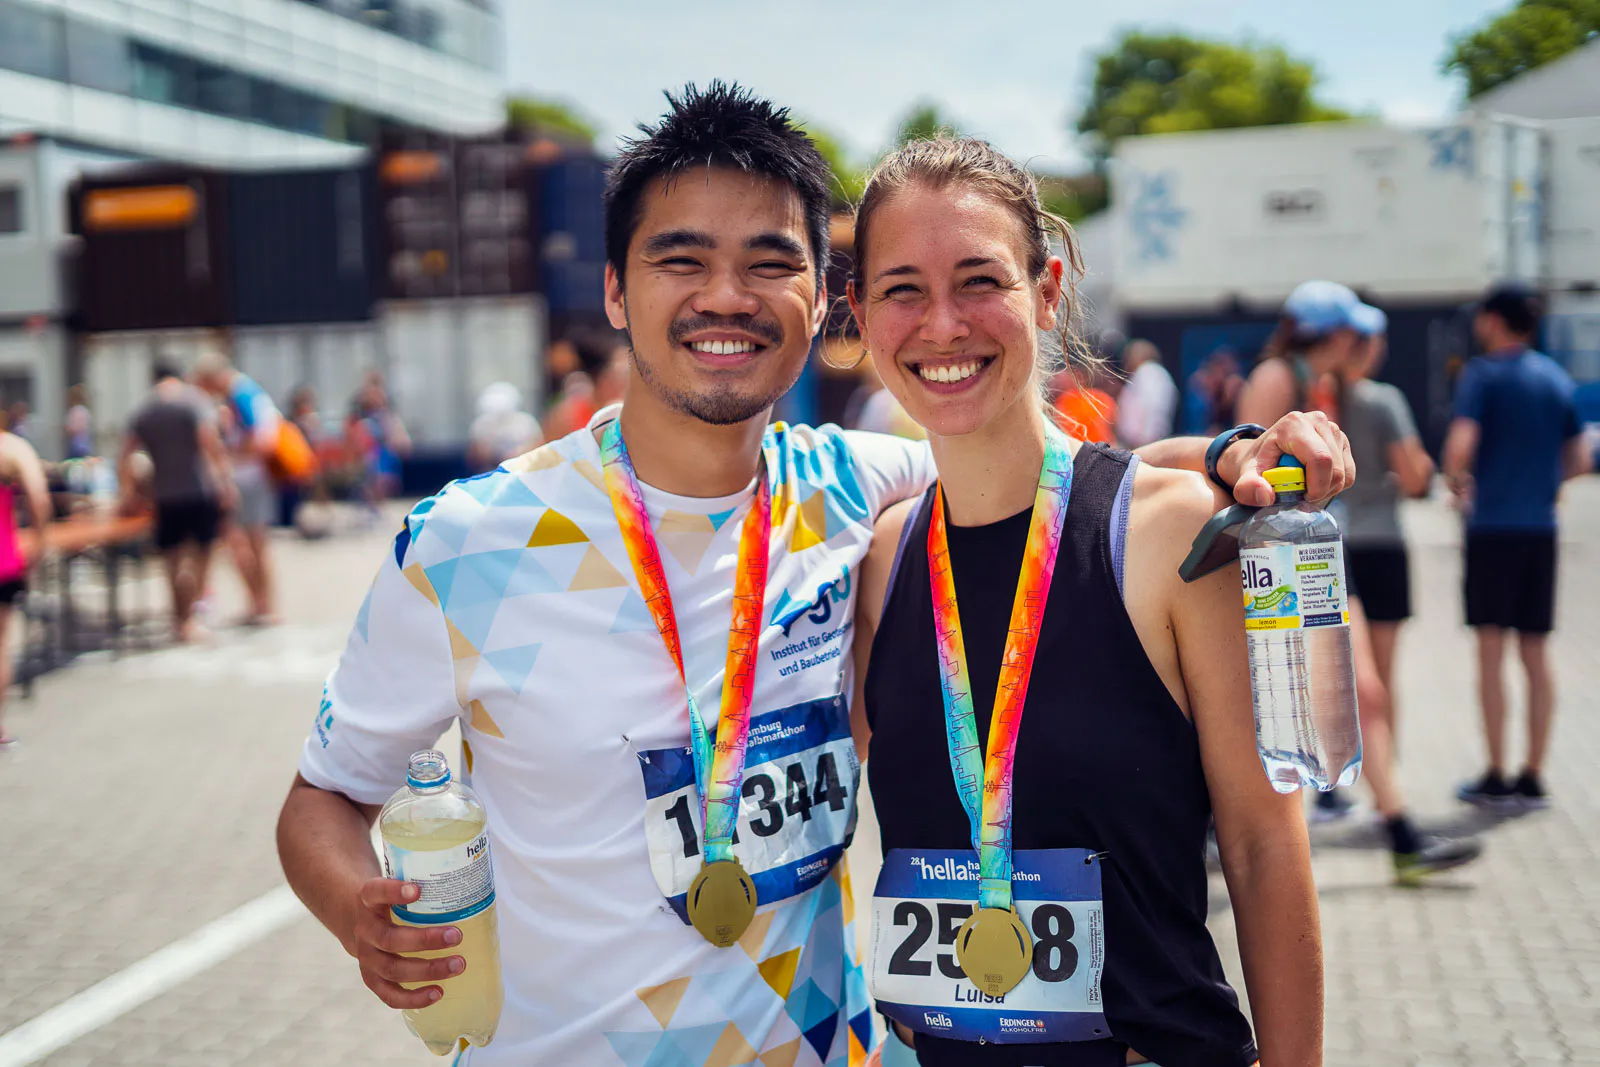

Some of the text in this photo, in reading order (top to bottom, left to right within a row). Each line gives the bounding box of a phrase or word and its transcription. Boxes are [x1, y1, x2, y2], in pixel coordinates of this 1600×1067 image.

[770, 639, 808, 661] Institut
[807, 635, 820, 649] für
[779, 646, 841, 677] und Baubetrieb
[748, 721, 782, 738] amburg
[748, 723, 806, 748] albmarathon
[665, 751, 848, 859] 1344
[921, 857, 969, 881] hella
[887, 901, 1079, 983] 258
[923, 1012, 953, 1028] hella
[999, 1017, 1037, 1028] ERDINGER
